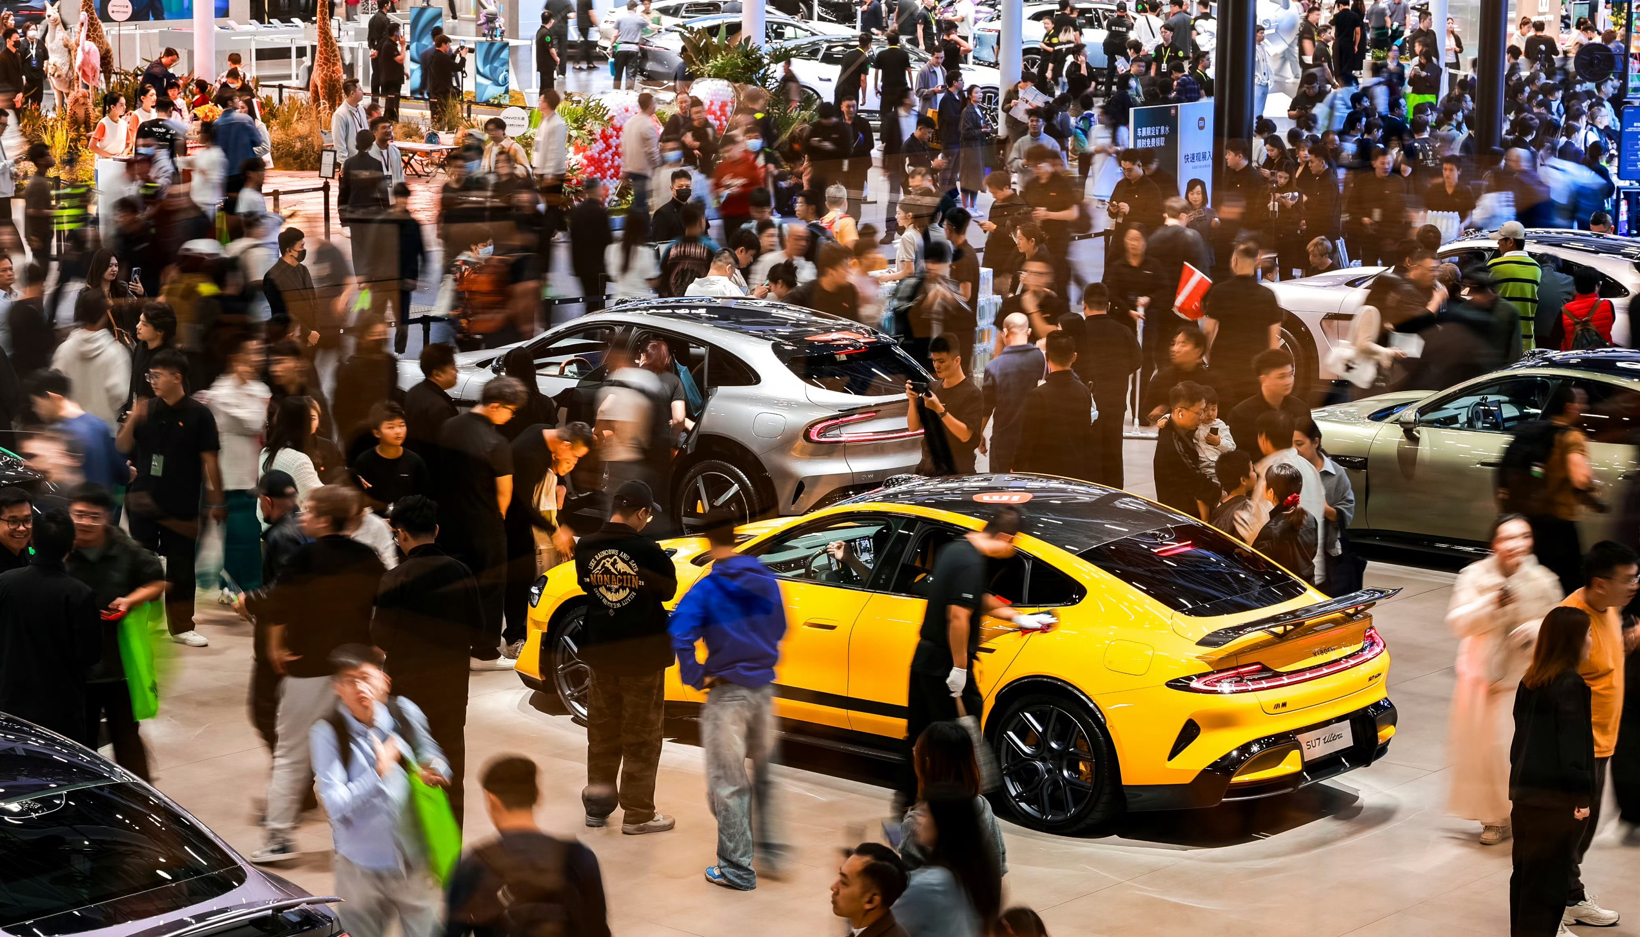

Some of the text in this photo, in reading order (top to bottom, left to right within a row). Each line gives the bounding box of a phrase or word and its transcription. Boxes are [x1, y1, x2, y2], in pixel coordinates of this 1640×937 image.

[1137, 125, 1170, 138] 车展限定矿泉水
[1136, 137, 1166, 149] 限时免费领取
[619, 551, 631, 561] AND
[1305, 732, 1344, 750] SU7 Ultra
